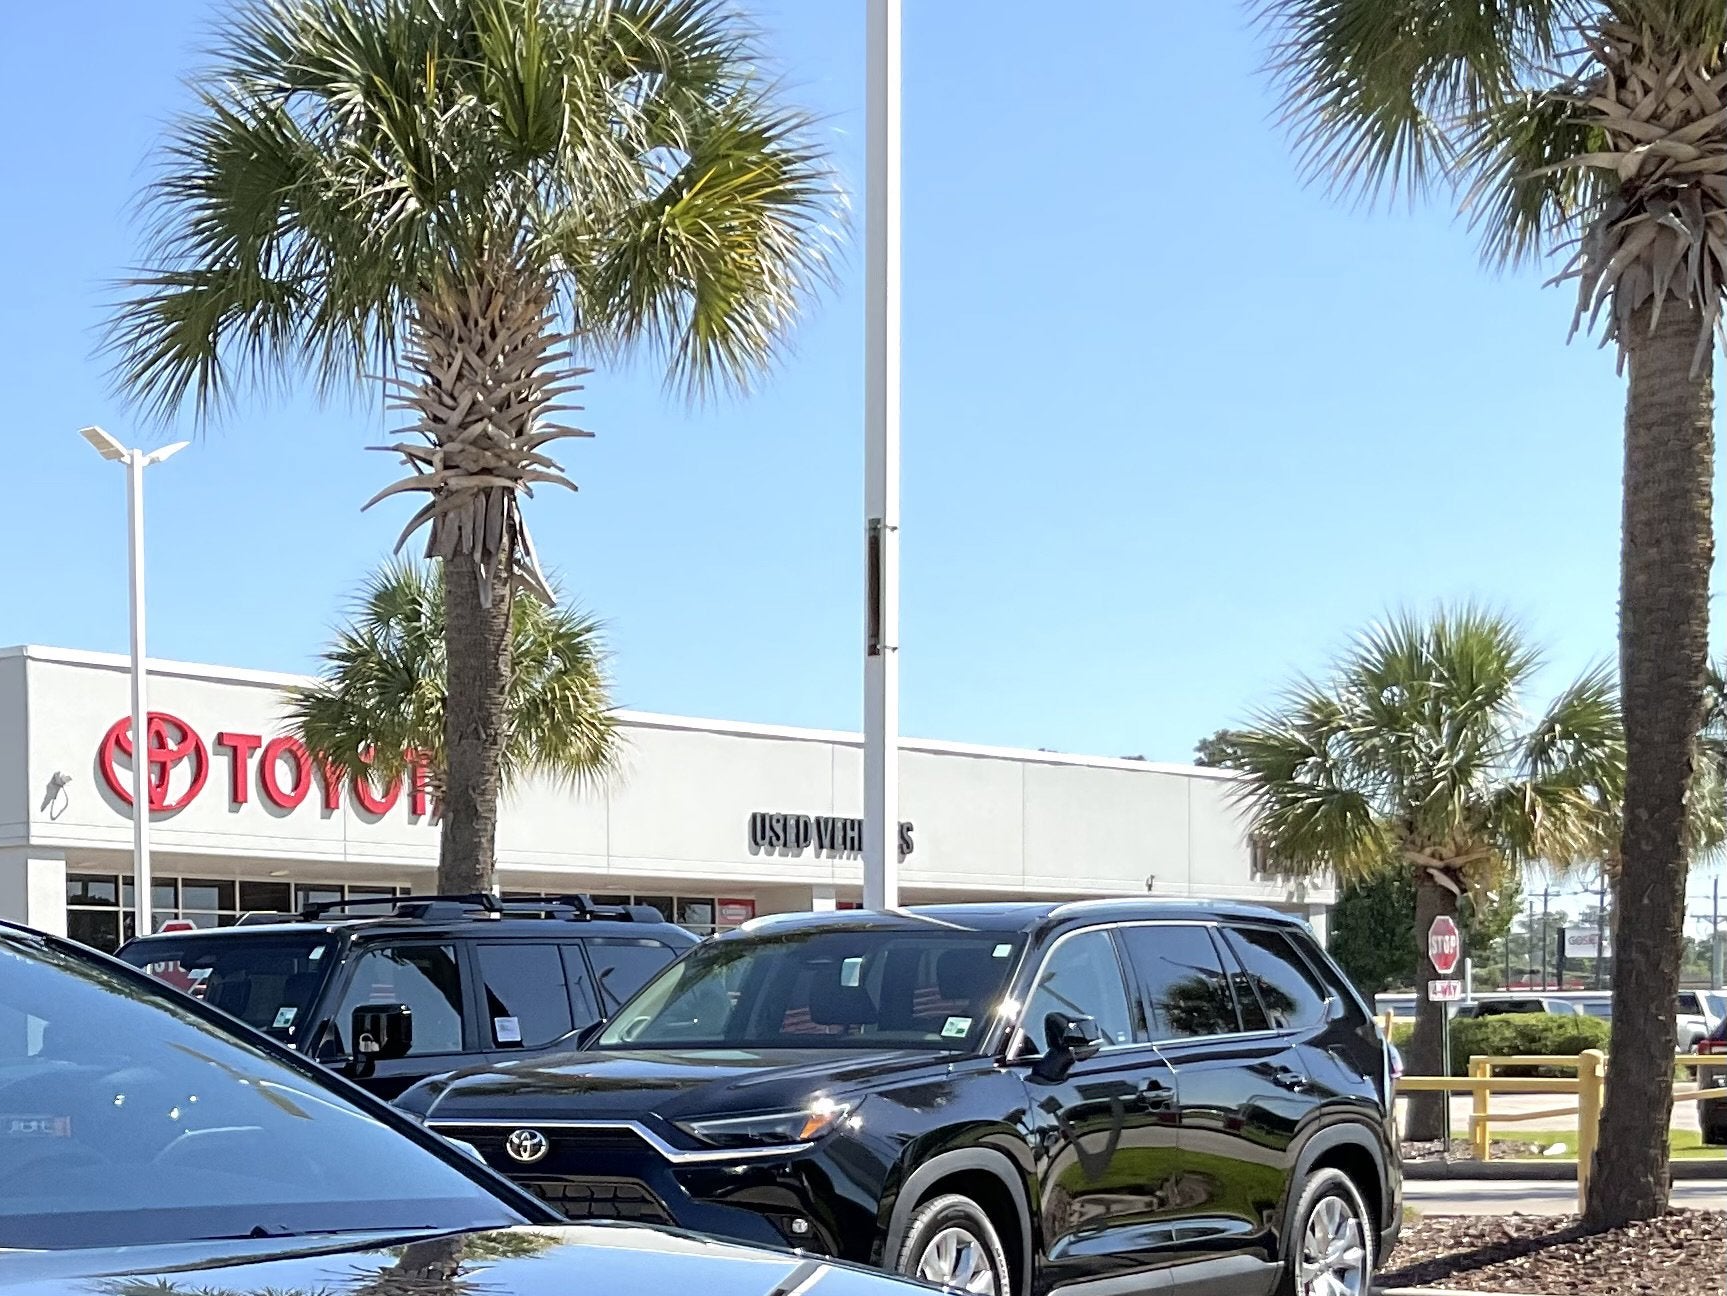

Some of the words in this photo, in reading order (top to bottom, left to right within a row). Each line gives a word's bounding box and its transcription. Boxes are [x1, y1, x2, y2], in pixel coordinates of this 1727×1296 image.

[218, 732, 442, 816] TOYOT
[751, 812, 811, 848] USED
[814, 815, 914, 855] VEHS
[1432, 935, 1456, 954] STOP
